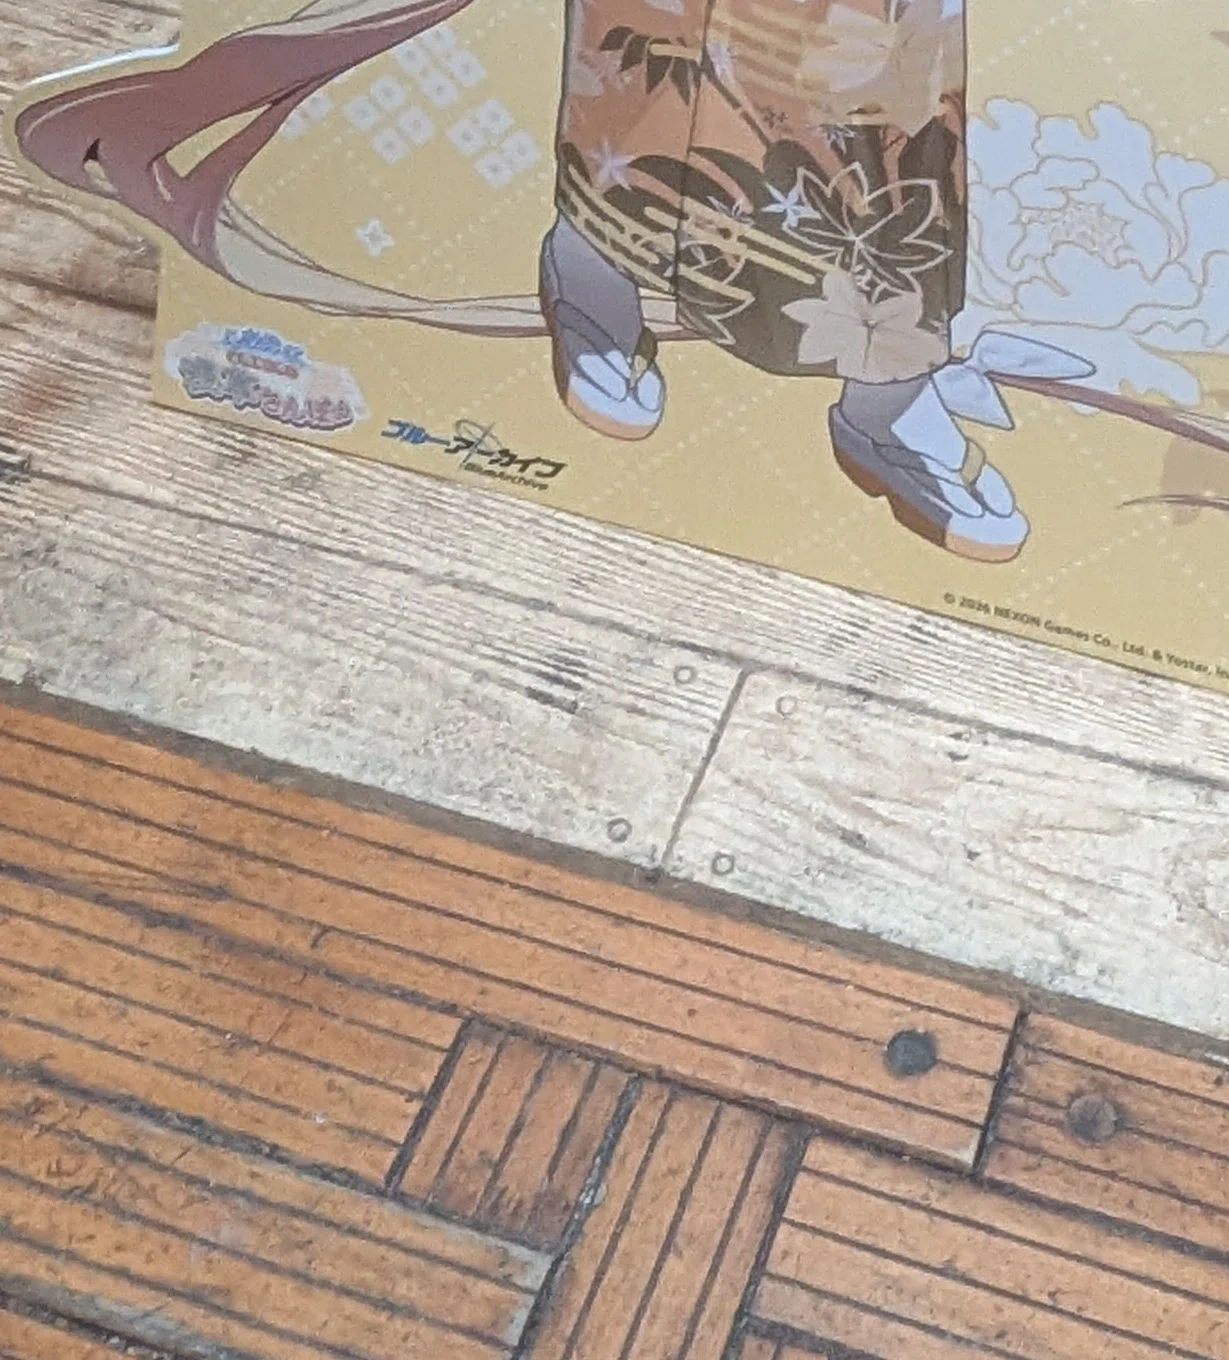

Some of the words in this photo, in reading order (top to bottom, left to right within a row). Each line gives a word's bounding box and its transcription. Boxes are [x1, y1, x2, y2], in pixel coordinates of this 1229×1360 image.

[993, 606, 1041, 628] NEXON
[1044, 619, 1090, 642] Games
[1152, 649, 1163, 662] &
